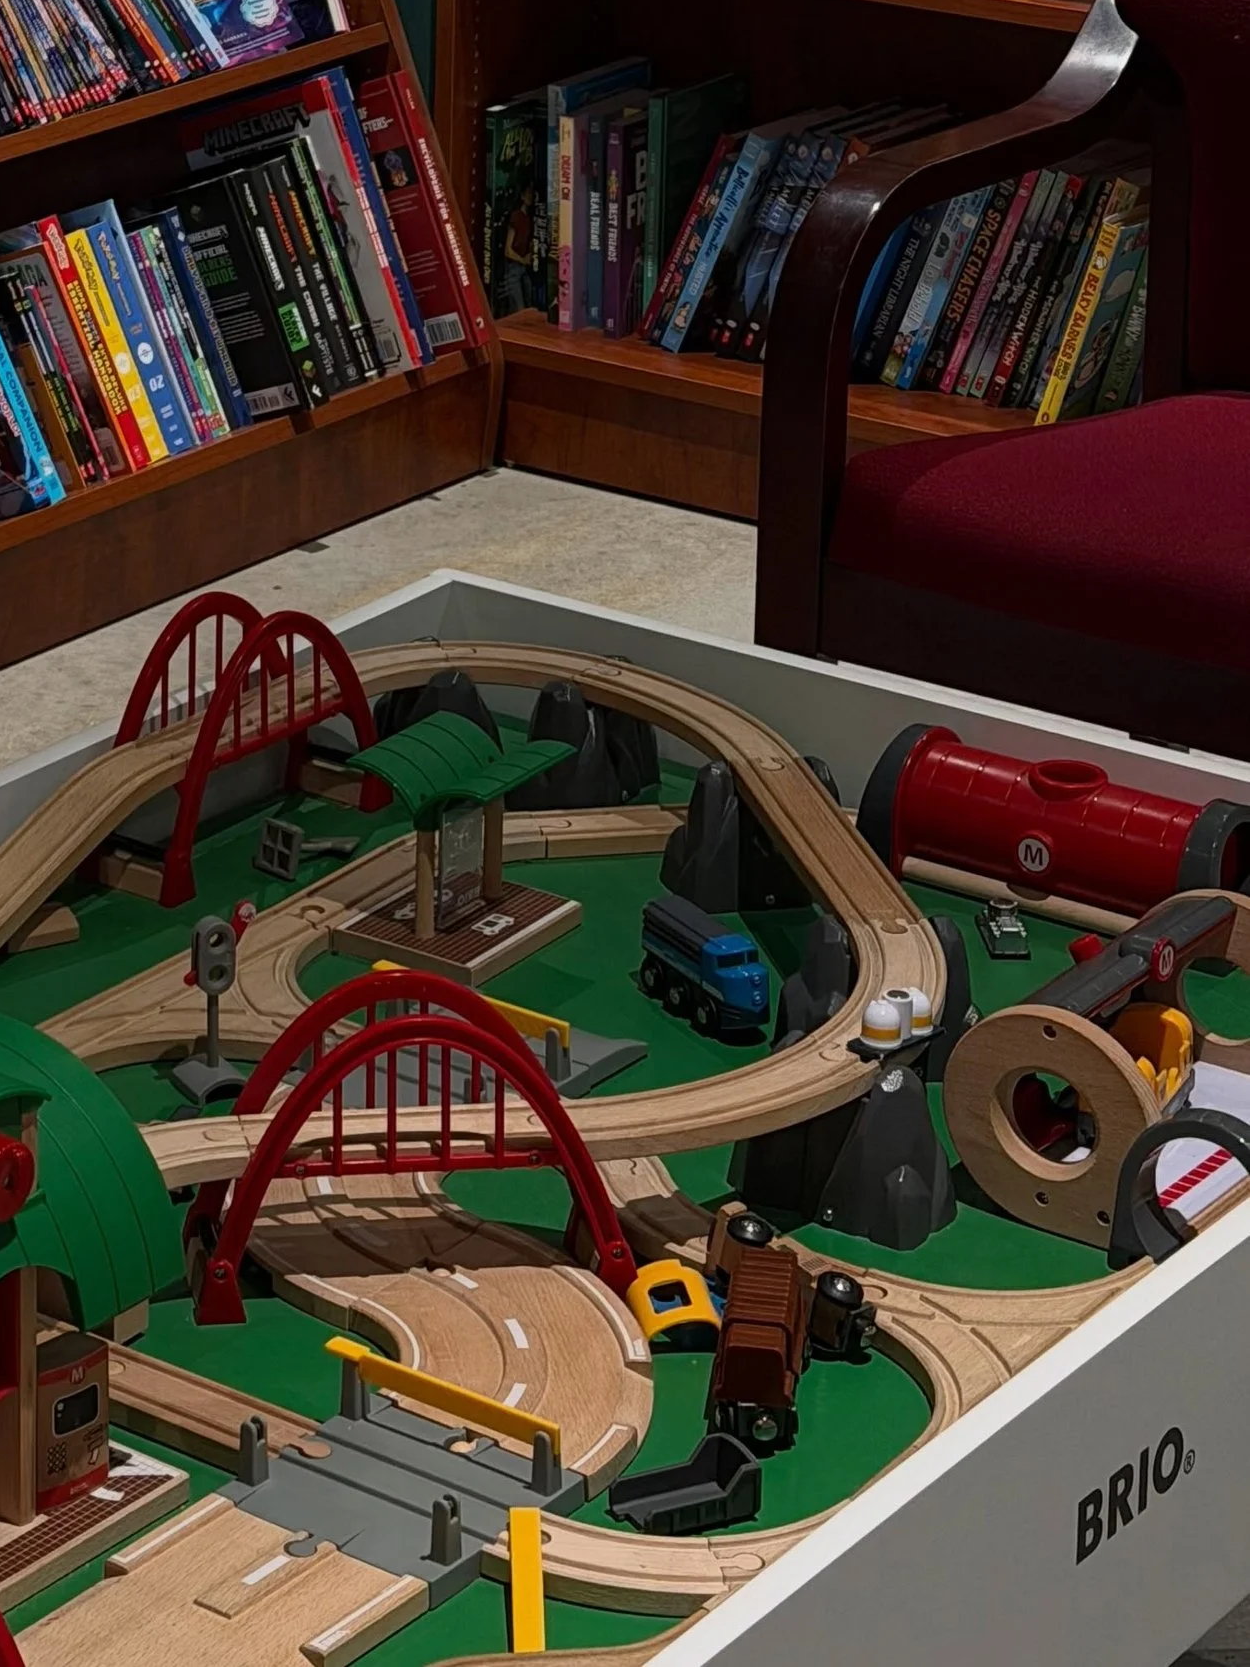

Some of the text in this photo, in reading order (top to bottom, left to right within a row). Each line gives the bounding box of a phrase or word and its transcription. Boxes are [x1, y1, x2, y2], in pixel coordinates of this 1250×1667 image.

[202, 104, 311, 155] MINECRAFT
[590, 190, 600, 252] REAL FRIENDS
[608, 202, 619, 263] BEST FRIENDS
[940, 207, 1002, 330] SPACE CHASERS
[1059, 271, 1100, 359] BEAKY BARNES
[5, 368, 43, 453] COMPANION
[1023, 843, 1043, 867] M
[1160, 945, 1171, 972] M
[1076, 1425, 1185, 1567] BRIO
